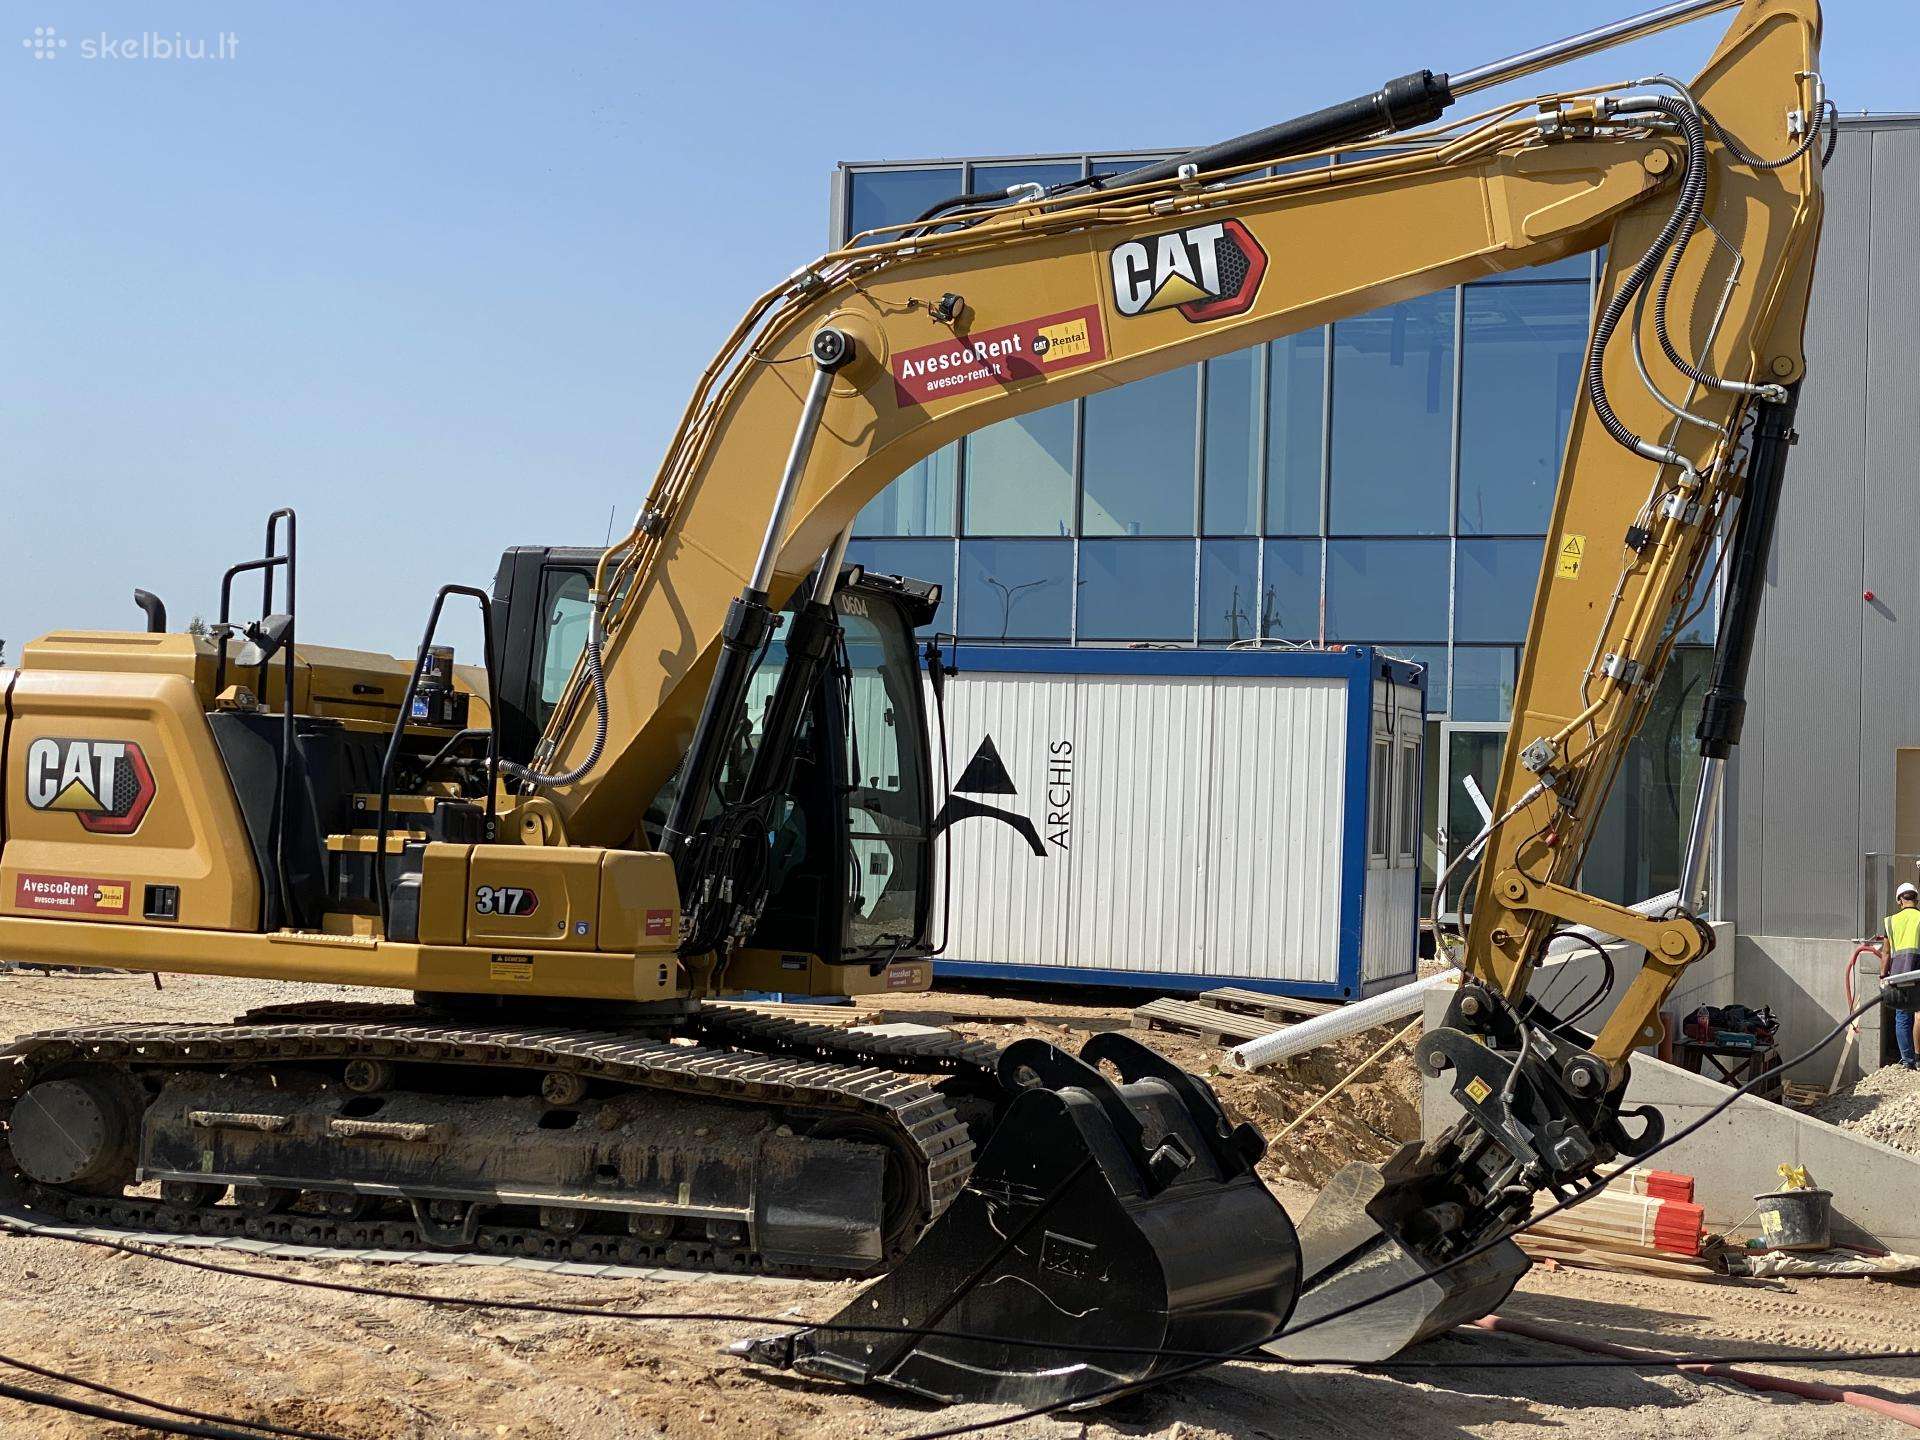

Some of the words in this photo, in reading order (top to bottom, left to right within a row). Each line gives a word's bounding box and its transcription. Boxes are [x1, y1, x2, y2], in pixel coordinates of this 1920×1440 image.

[1111, 222, 1224, 316] CAT
[1033, 340, 1047, 352] CAT
[1051, 331, 1086, 347] Rental
[902, 333, 1022, 380] AvescoRent
[926, 363, 1002, 391] avesco-rent.lt
[841, 594, 869, 618] 0604
[28, 738, 125, 811] CAT
[1047, 740, 1073, 850] ARCHIS
[23, 878, 89, 896] AvescoRent
[34, 896, 75, 906] avesco-rent.lt
[476, 886, 524, 914] 317
